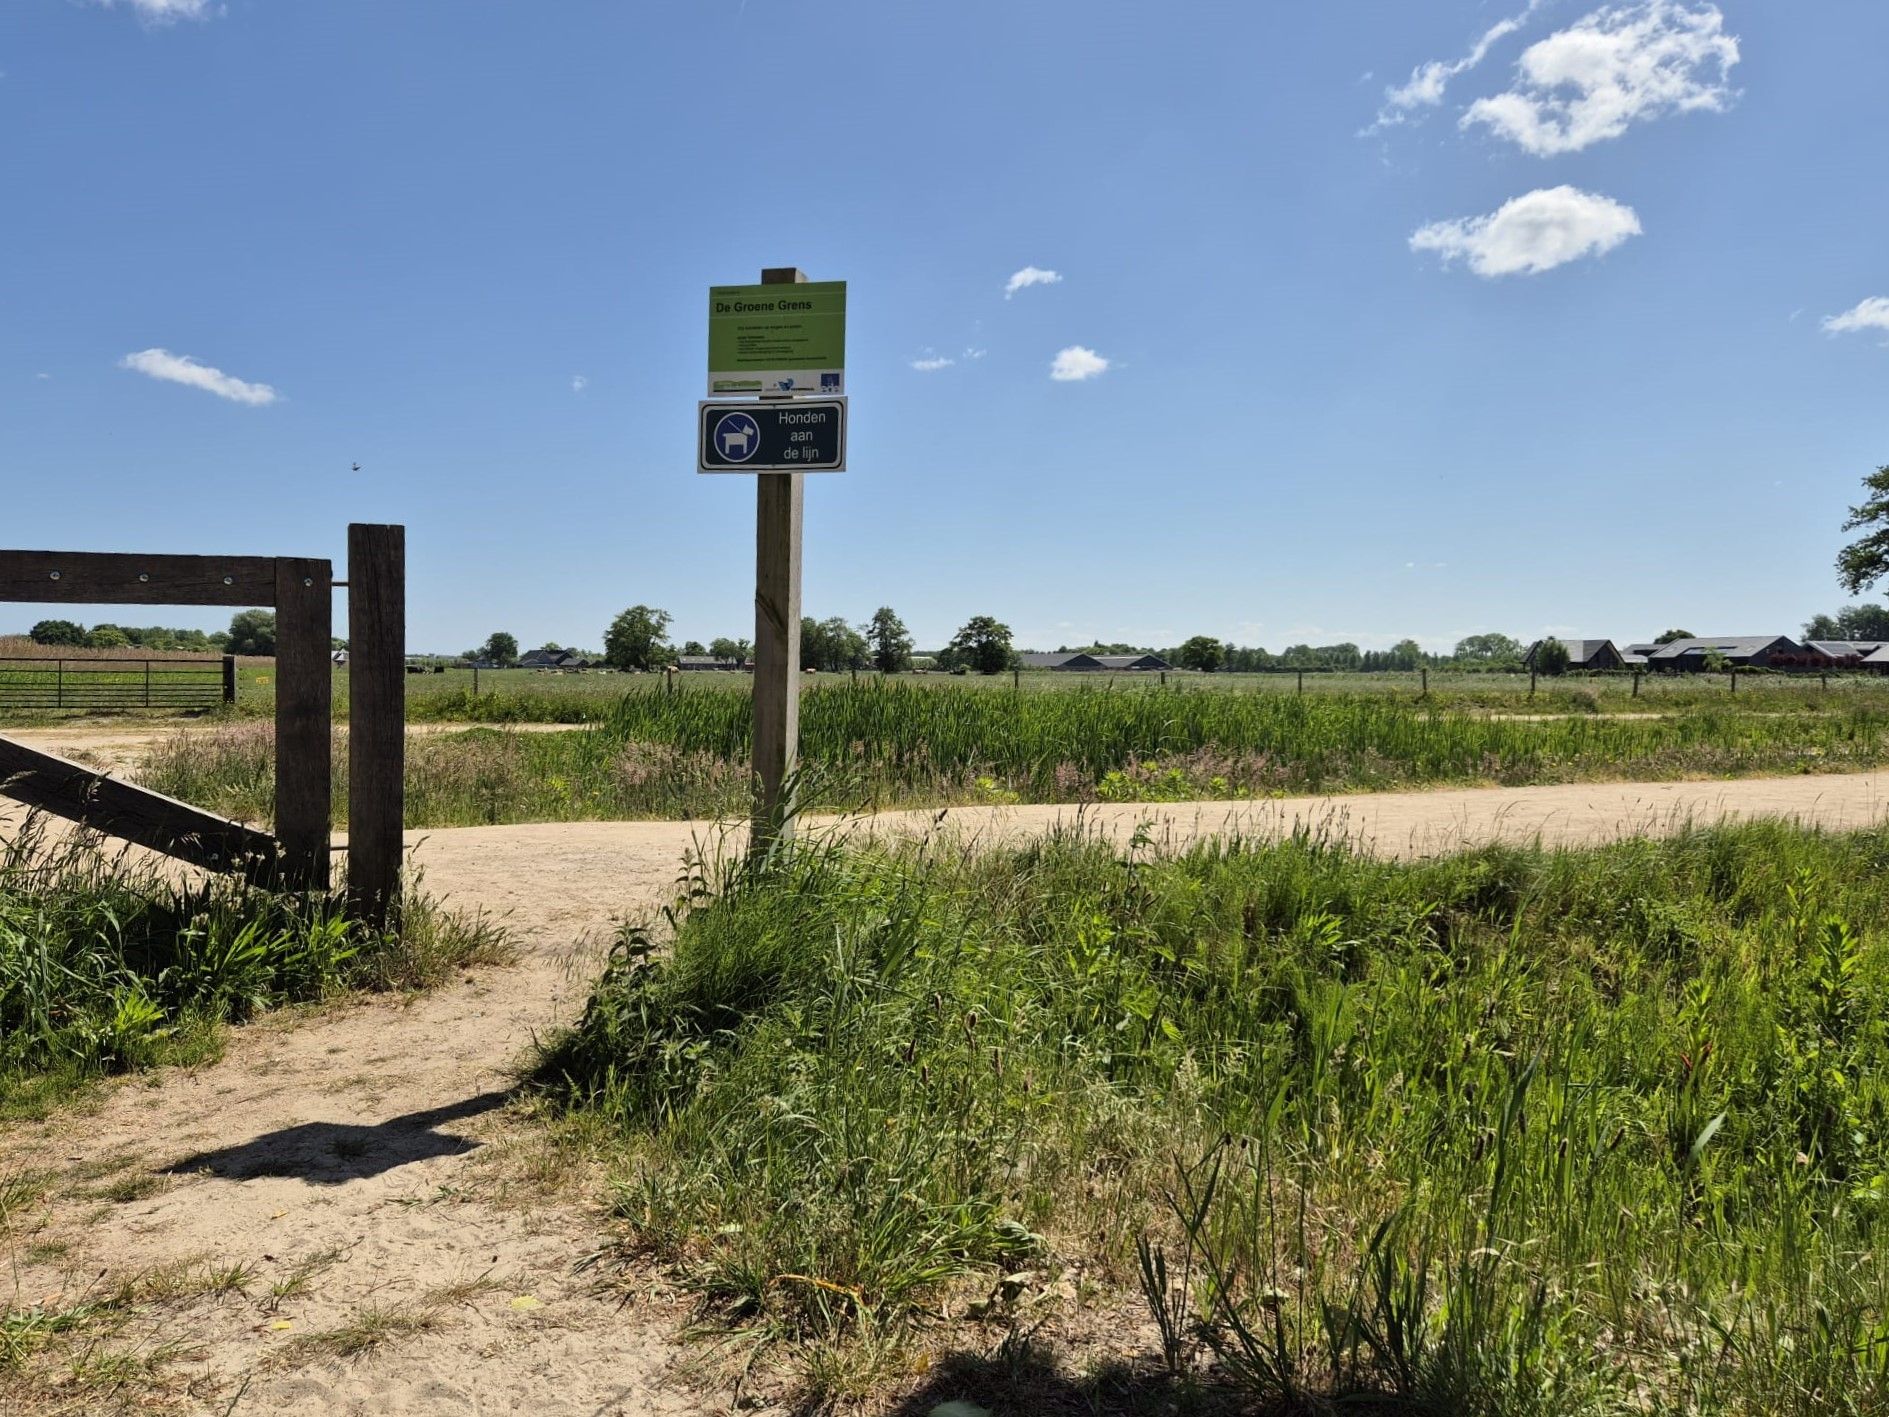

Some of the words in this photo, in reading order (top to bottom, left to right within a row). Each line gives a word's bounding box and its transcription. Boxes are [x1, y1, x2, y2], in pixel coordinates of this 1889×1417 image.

[716, 302, 731, 313] De
[734, 301, 774, 312] Groene
[778, 300, 812, 310] Grens
[779, 411, 826, 424] Honden
[790, 431, 813, 442] aan
[784, 447, 799, 460] de
[802, 446, 819, 462] lijn
